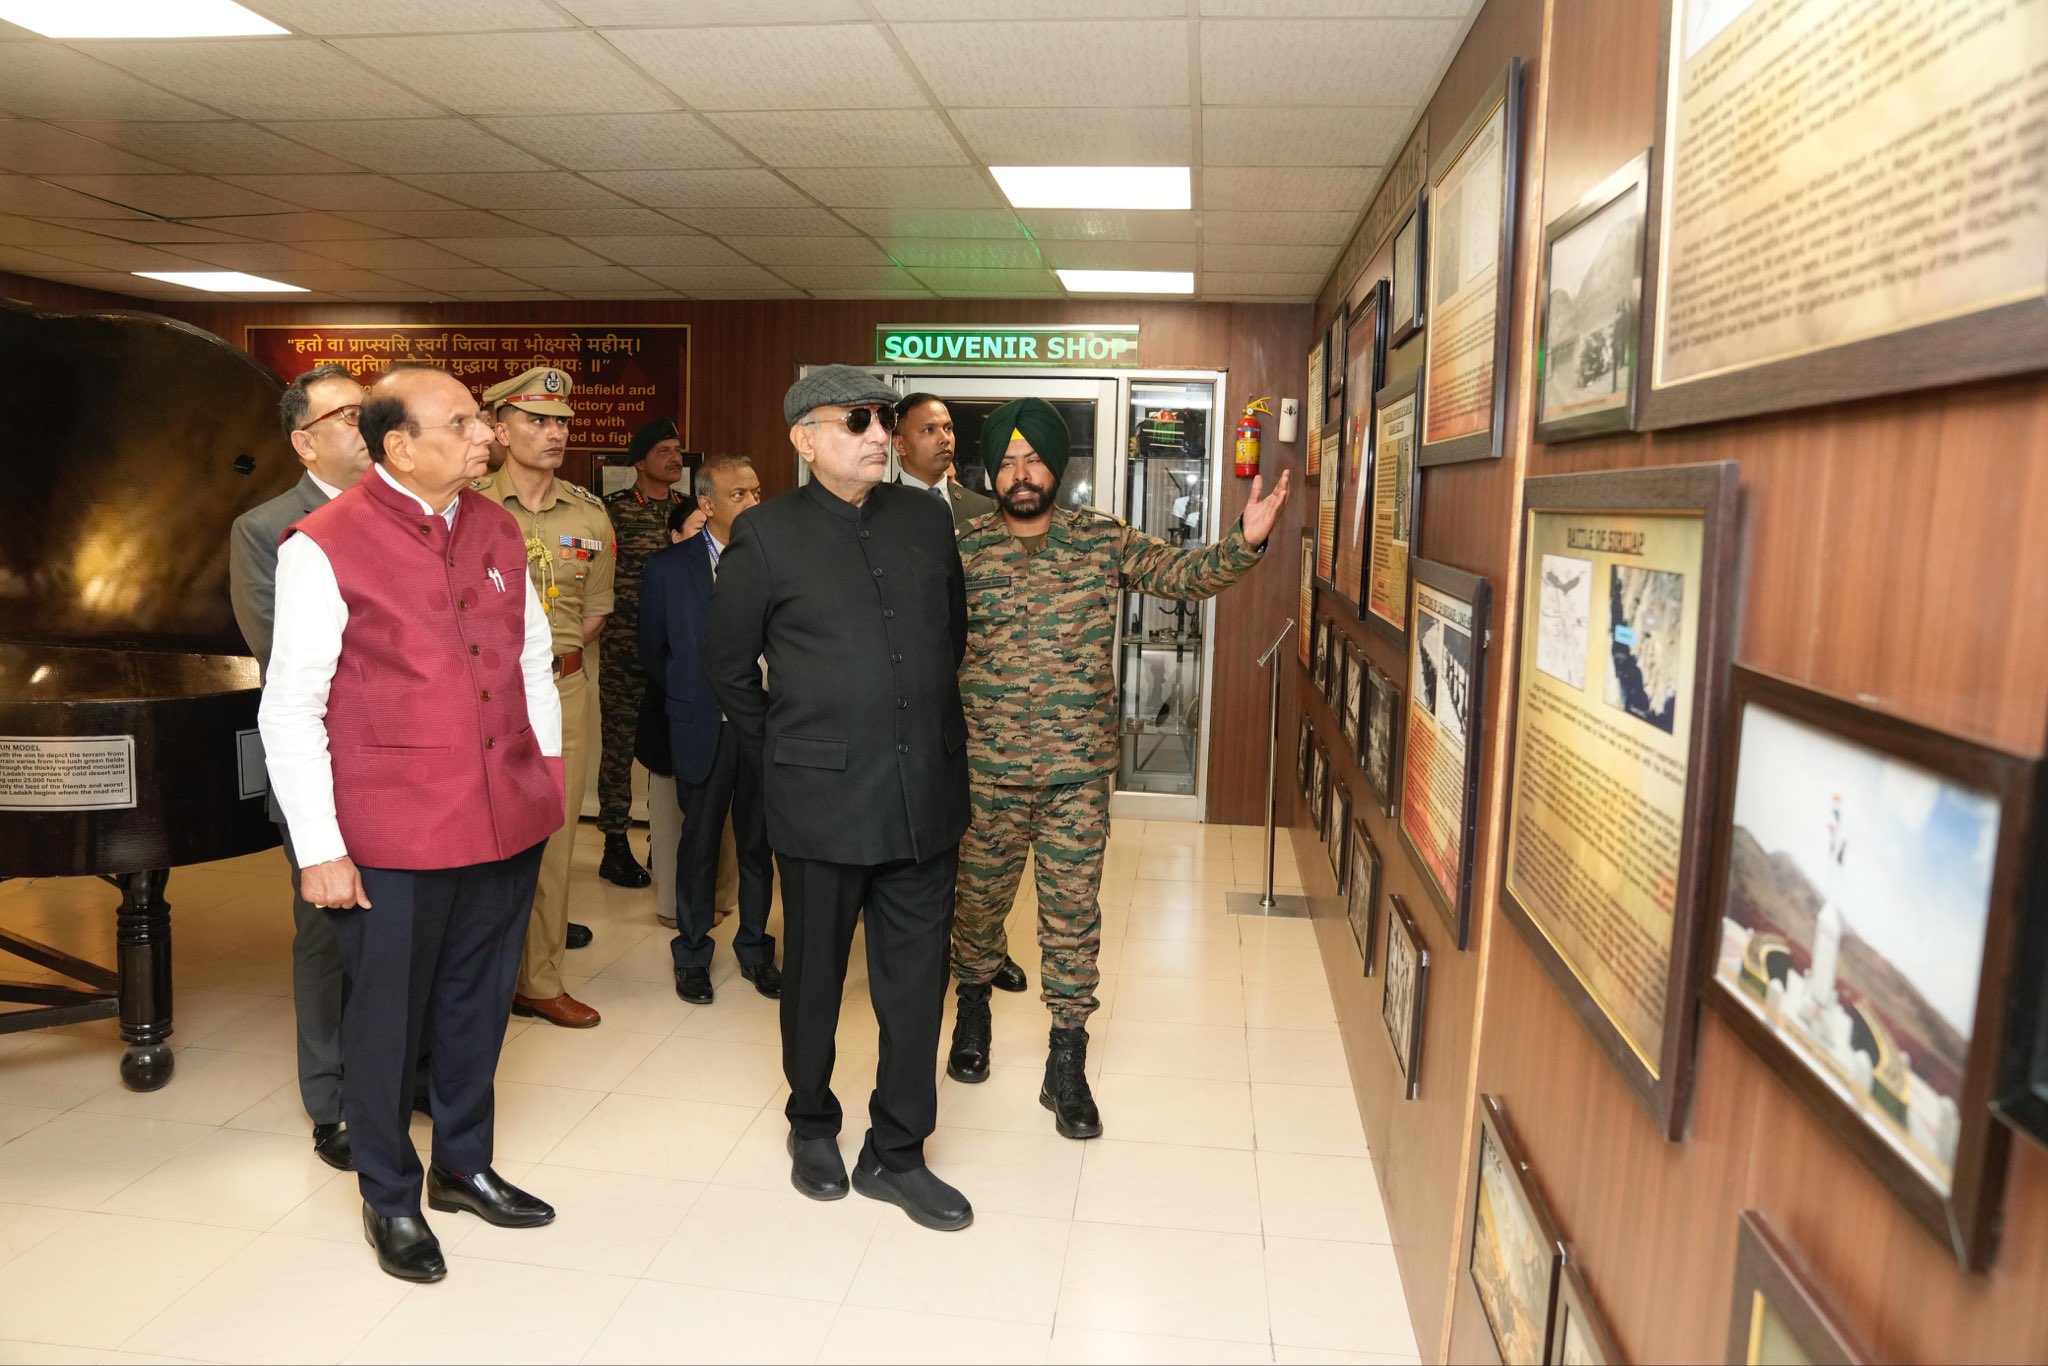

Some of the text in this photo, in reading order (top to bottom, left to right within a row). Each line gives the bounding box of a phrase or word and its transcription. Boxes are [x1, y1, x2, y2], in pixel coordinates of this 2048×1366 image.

[327, 338, 344, 351] वा
[348, 334, 410, 352] प्राप्स्यसि
[452, 334, 496, 352] जित्वा
[501, 338, 519, 351] वा
[525, 334, 582, 353] भोक्ष्यसे
[885, 336, 1129, 360] SOUVENIR SHOP
[570, 384, 624, 396] ttlefield
[628, 384, 656, 396] and
[617, 400, 645, 412] and
[595, 416, 625, 427] with
[591, 432, 605, 443] to
[608, 431, 634, 445] figh
[1568, 527, 1594, 549] BATTLE
